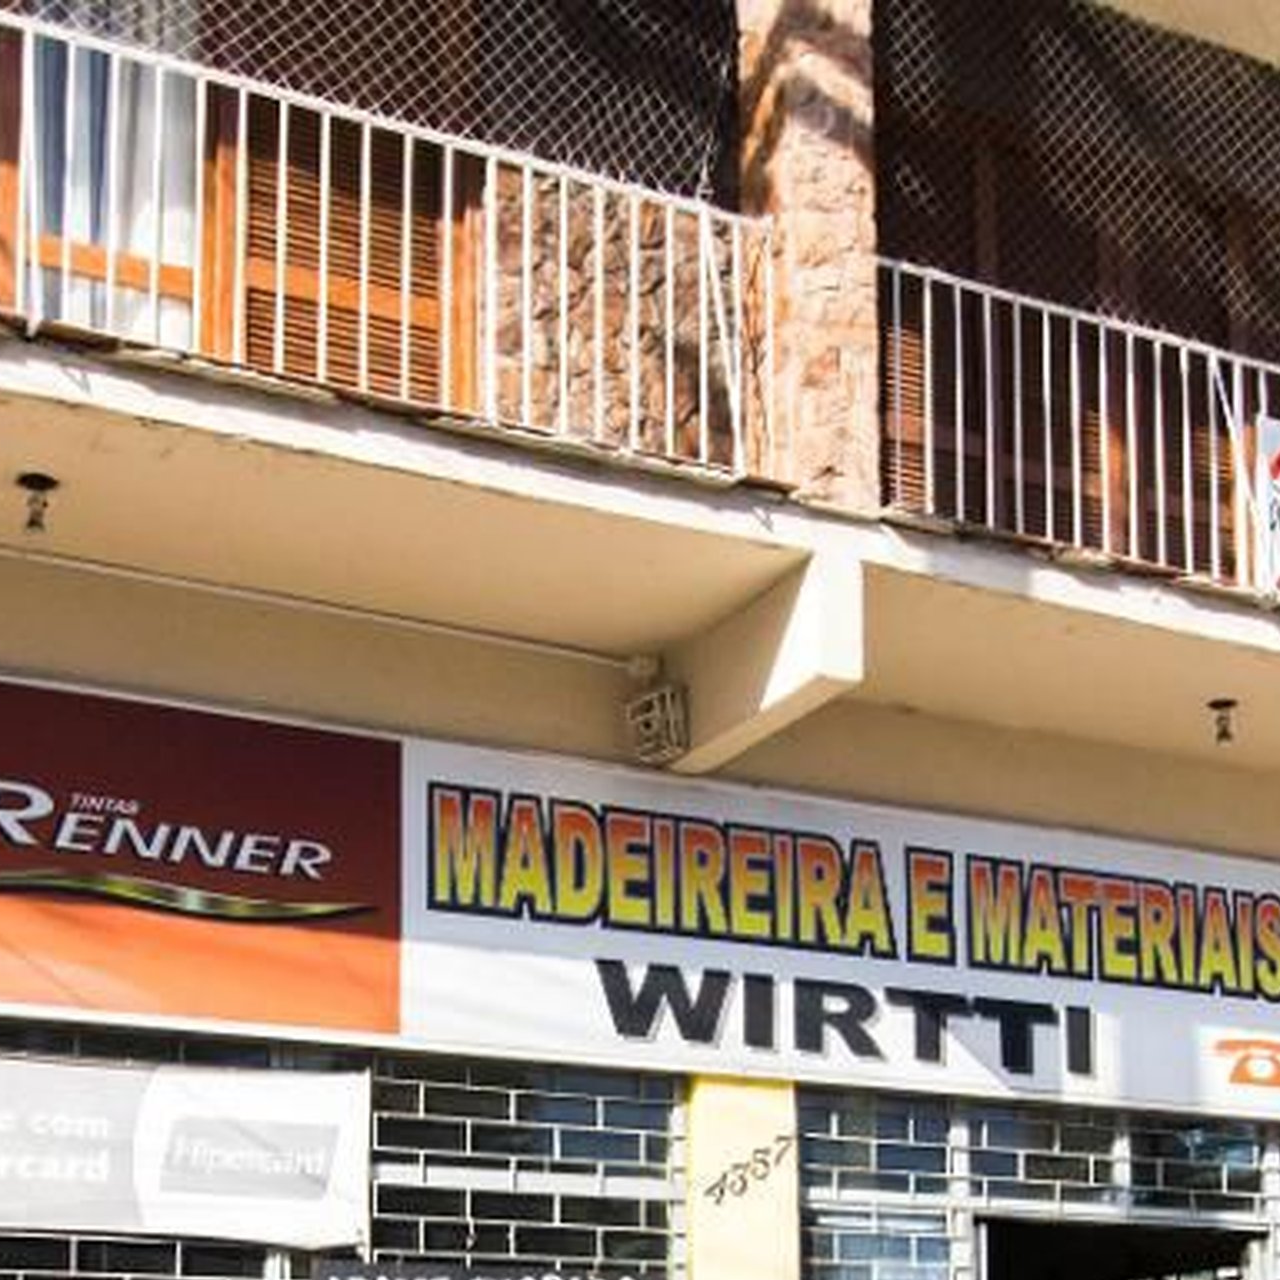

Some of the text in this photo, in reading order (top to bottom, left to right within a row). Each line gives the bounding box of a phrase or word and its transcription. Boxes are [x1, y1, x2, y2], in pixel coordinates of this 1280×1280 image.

[69, 793, 139, 815] TINTAS
[427, 781, 898, 960] MADEIREIRA
[905, 846, 957, 967] E
[595, 958, 1095, 1076] WIRTTI
[32, 1111, 109, 1138] com
[703, 1134, 794, 1206] 4357
